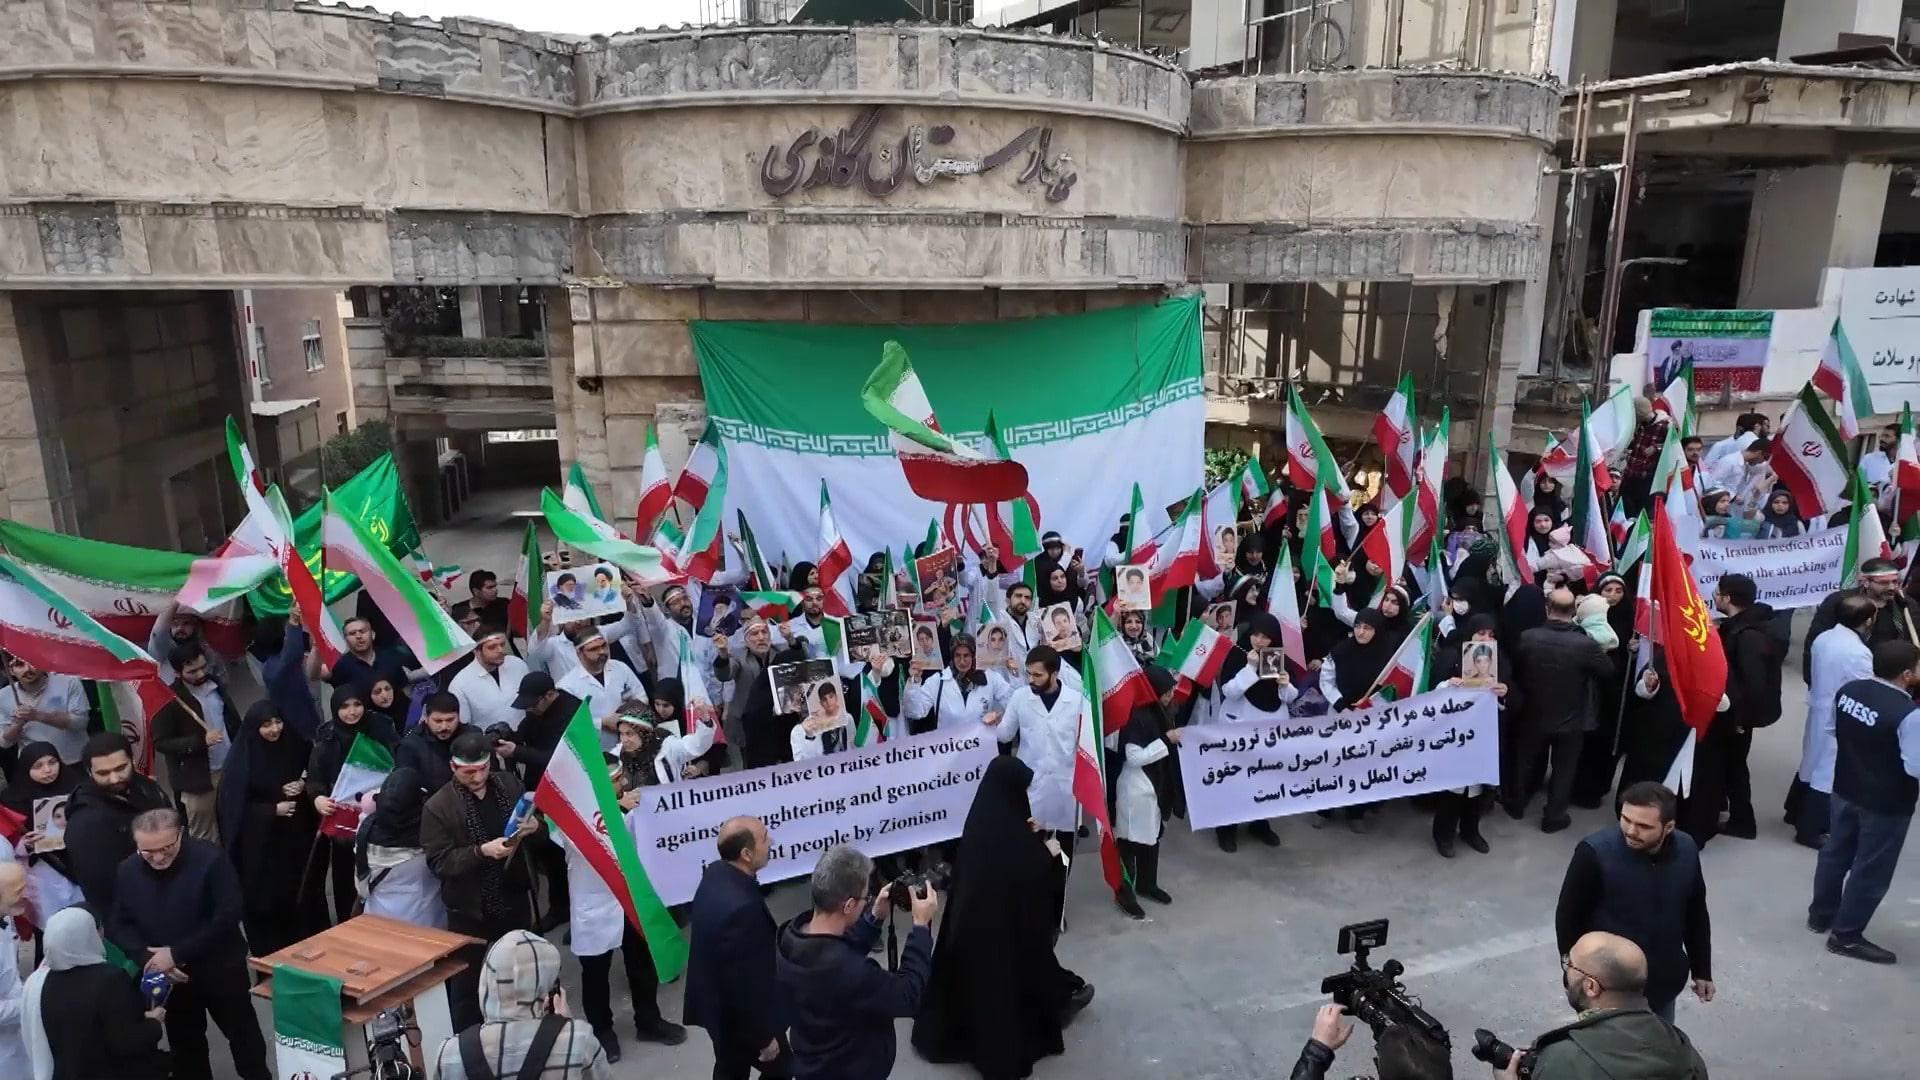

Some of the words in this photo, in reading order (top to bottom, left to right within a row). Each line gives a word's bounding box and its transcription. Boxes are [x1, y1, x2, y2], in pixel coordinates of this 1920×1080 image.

[760, 103, 883, 198] گاندی
[1726, 545, 1766, 558] Iranian
[1768, 537, 1814, 552] medical
[1817, 533, 1844, 548] staff
[1756, 566, 1774, 579] the
[1777, 560, 1827, 577] attacking
[1829, 558, 1840, 569] of
[1765, 583, 1809, 598] medical
[1422, 707, 1436, 721] به
[1440, 697, 1474, 715] حمله
[1837, 694, 1878, 727] PRESS
[1318, 714, 1370, 739] درمانی
[1377, 707, 1417, 728] مراکز
[1199, 728, 1259, 755] تروریسم
[1265, 723, 1313, 746] مصداق
[1418, 739, 1425, 751] و
[1429, 728, 1474, 750] دولتی
[1332, 740, 1377, 767] آشکار
[1381, 736, 1413, 758] نقض
[1247, 759, 1283, 777] مسلم
[1288, 751, 1328, 772] اصول
[655, 791, 684, 813] All
[690, 778, 766, 805] humans
[771, 769, 813, 788] have
[818, 765, 835, 778] to
[840, 755, 881, 774] raise
[885, 747, 925, 764] their
[929, 737, 980, 755] voices
[1202, 763, 1242, 785] حقوق
[1360, 767, 1398, 789] الملل
[1403, 765, 1426, 782] بین
[850, 786, 882, 806] and
[887, 771, 961, 803] genocide
[965, 764, 983, 782] of
[1253, 784, 1284, 803] است
[1290, 775, 1343, 799] انسانیت
[1348, 778, 1356, 792] و
[790, 830, 850, 859] people
[854, 825, 874, 842] by
[879, 808, 948, 834] Zionism
